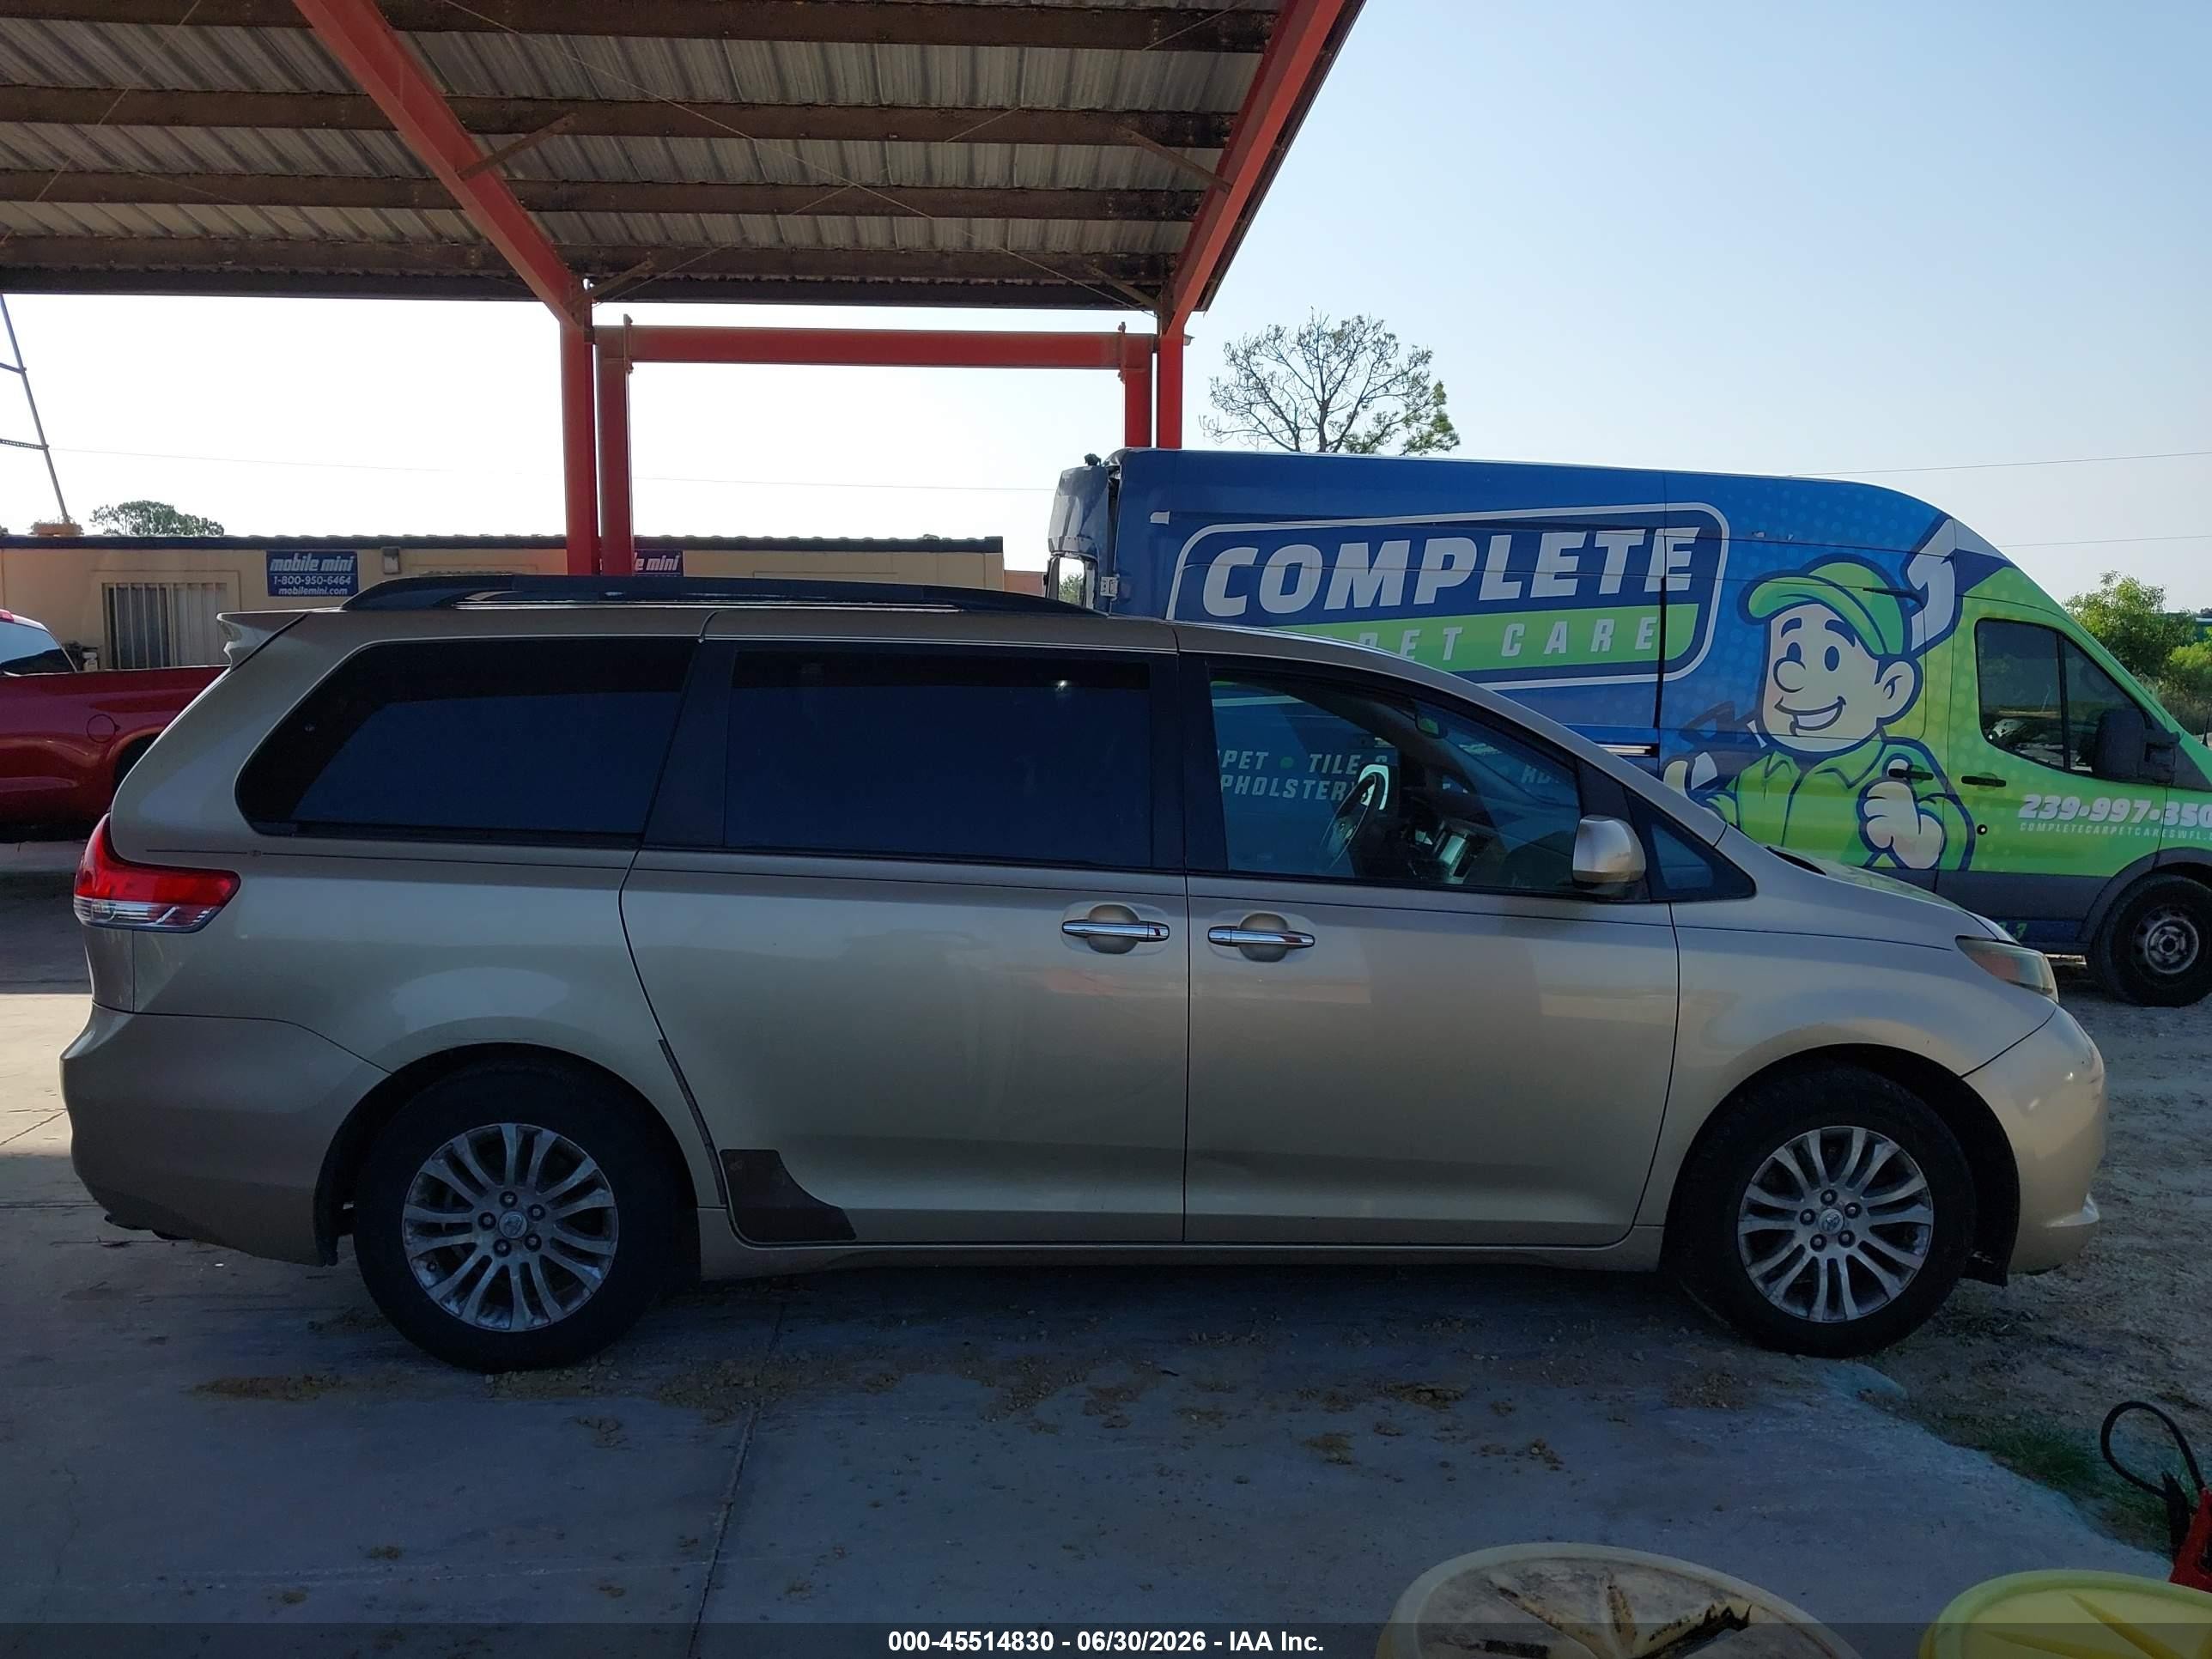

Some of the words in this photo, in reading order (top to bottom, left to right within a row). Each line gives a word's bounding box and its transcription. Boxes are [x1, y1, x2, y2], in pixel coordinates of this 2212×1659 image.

[270, 552, 318, 572] mobile
[320, 556, 355, 572] mini
[646, 555, 680, 571] mini
[1202, 526, 1701, 617] COMPLETE
[274, 575, 351, 585] 1-800-950-6464
[278, 586, 348, 595] mobilemini.com
[1500, 616, 1659, 658] CARE
[1218, 749, 1269, 770] PET
[1308, 753, 1361, 775] TILE
[1221, 775, 1355, 802] PHOLSTER
